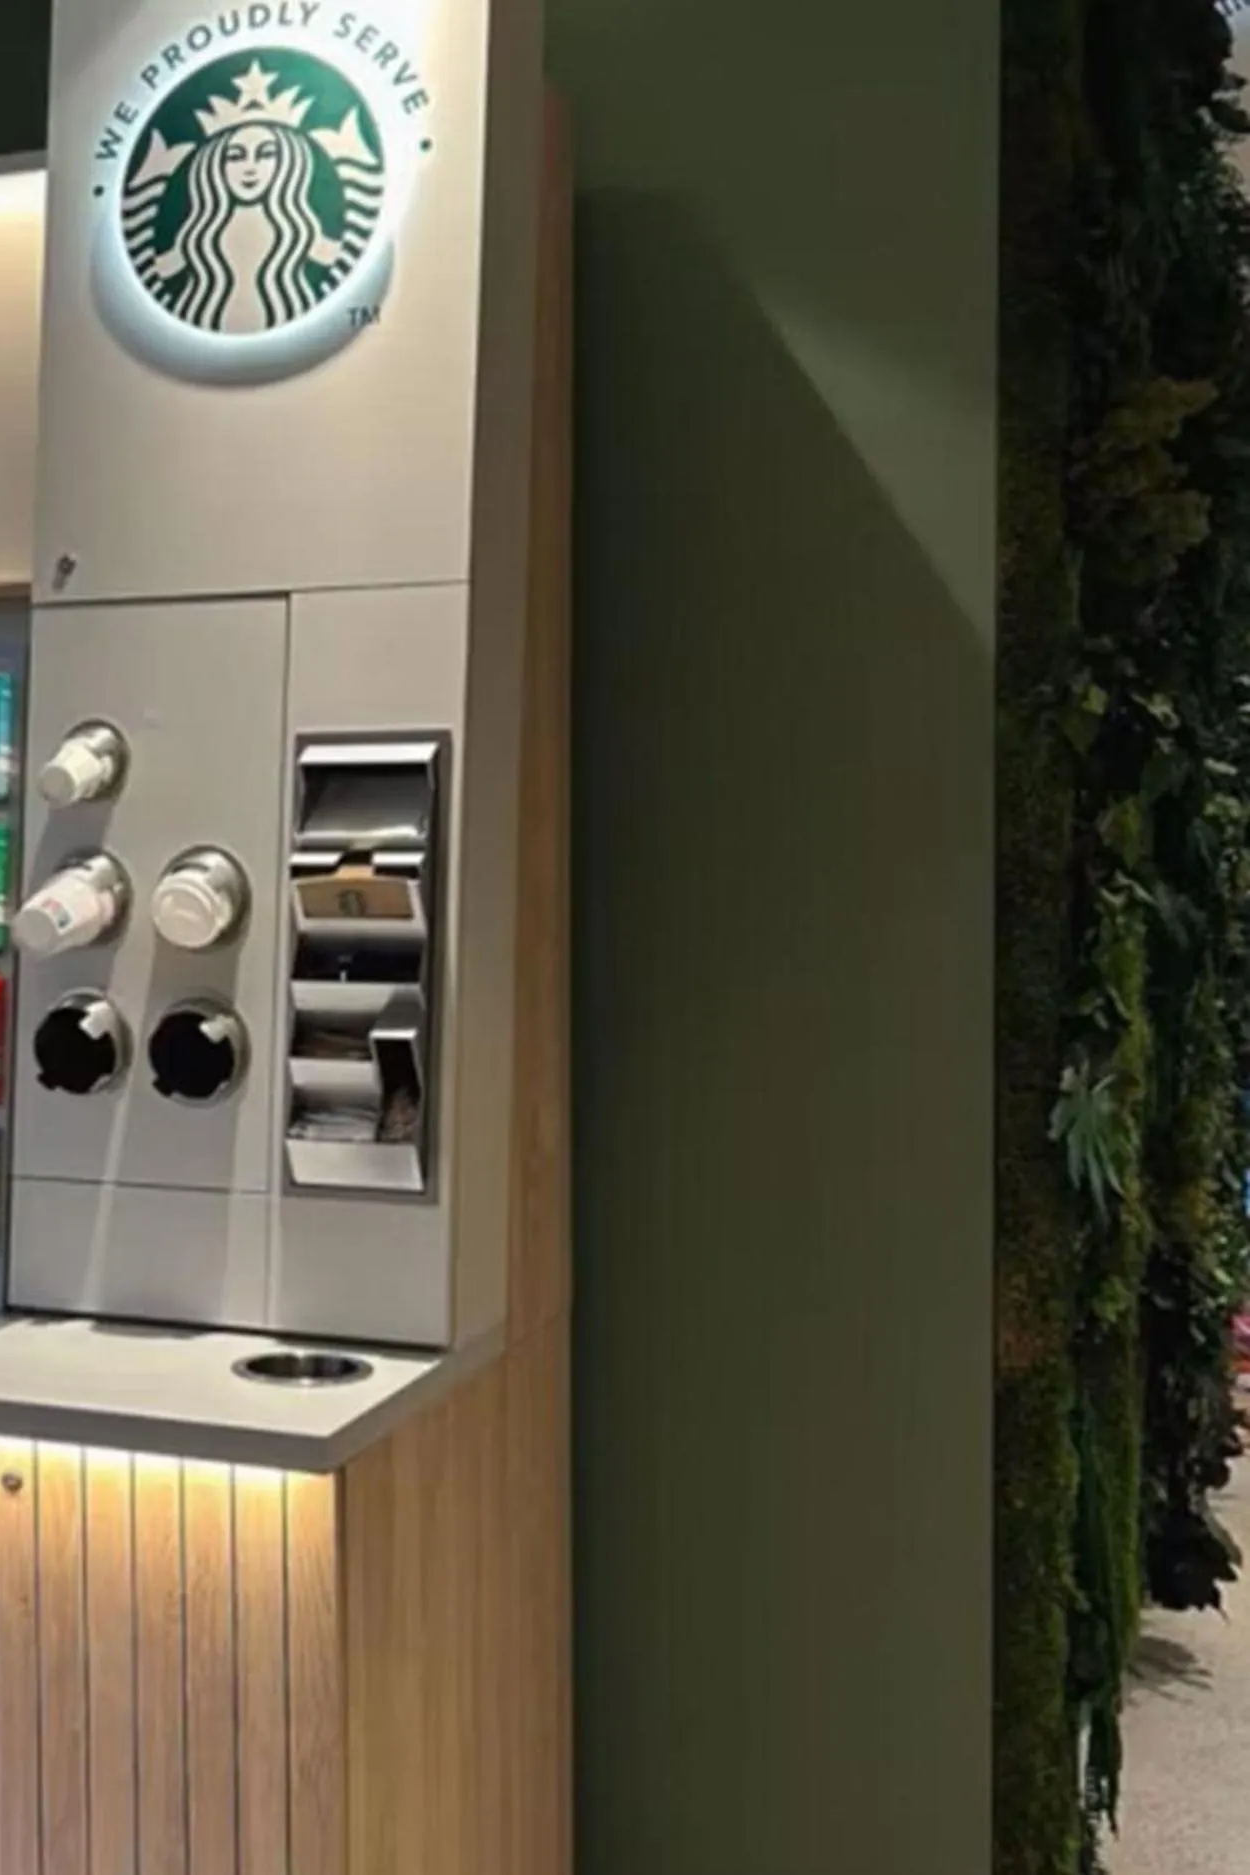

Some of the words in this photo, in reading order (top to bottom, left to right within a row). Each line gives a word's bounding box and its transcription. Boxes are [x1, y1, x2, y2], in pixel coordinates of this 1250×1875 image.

[95, 101, 139, 160] WE
[140, 2, 320, 91] PROUDLY
[333, 12, 430, 115] SERVE
[347, 306, 380, 327] TM
